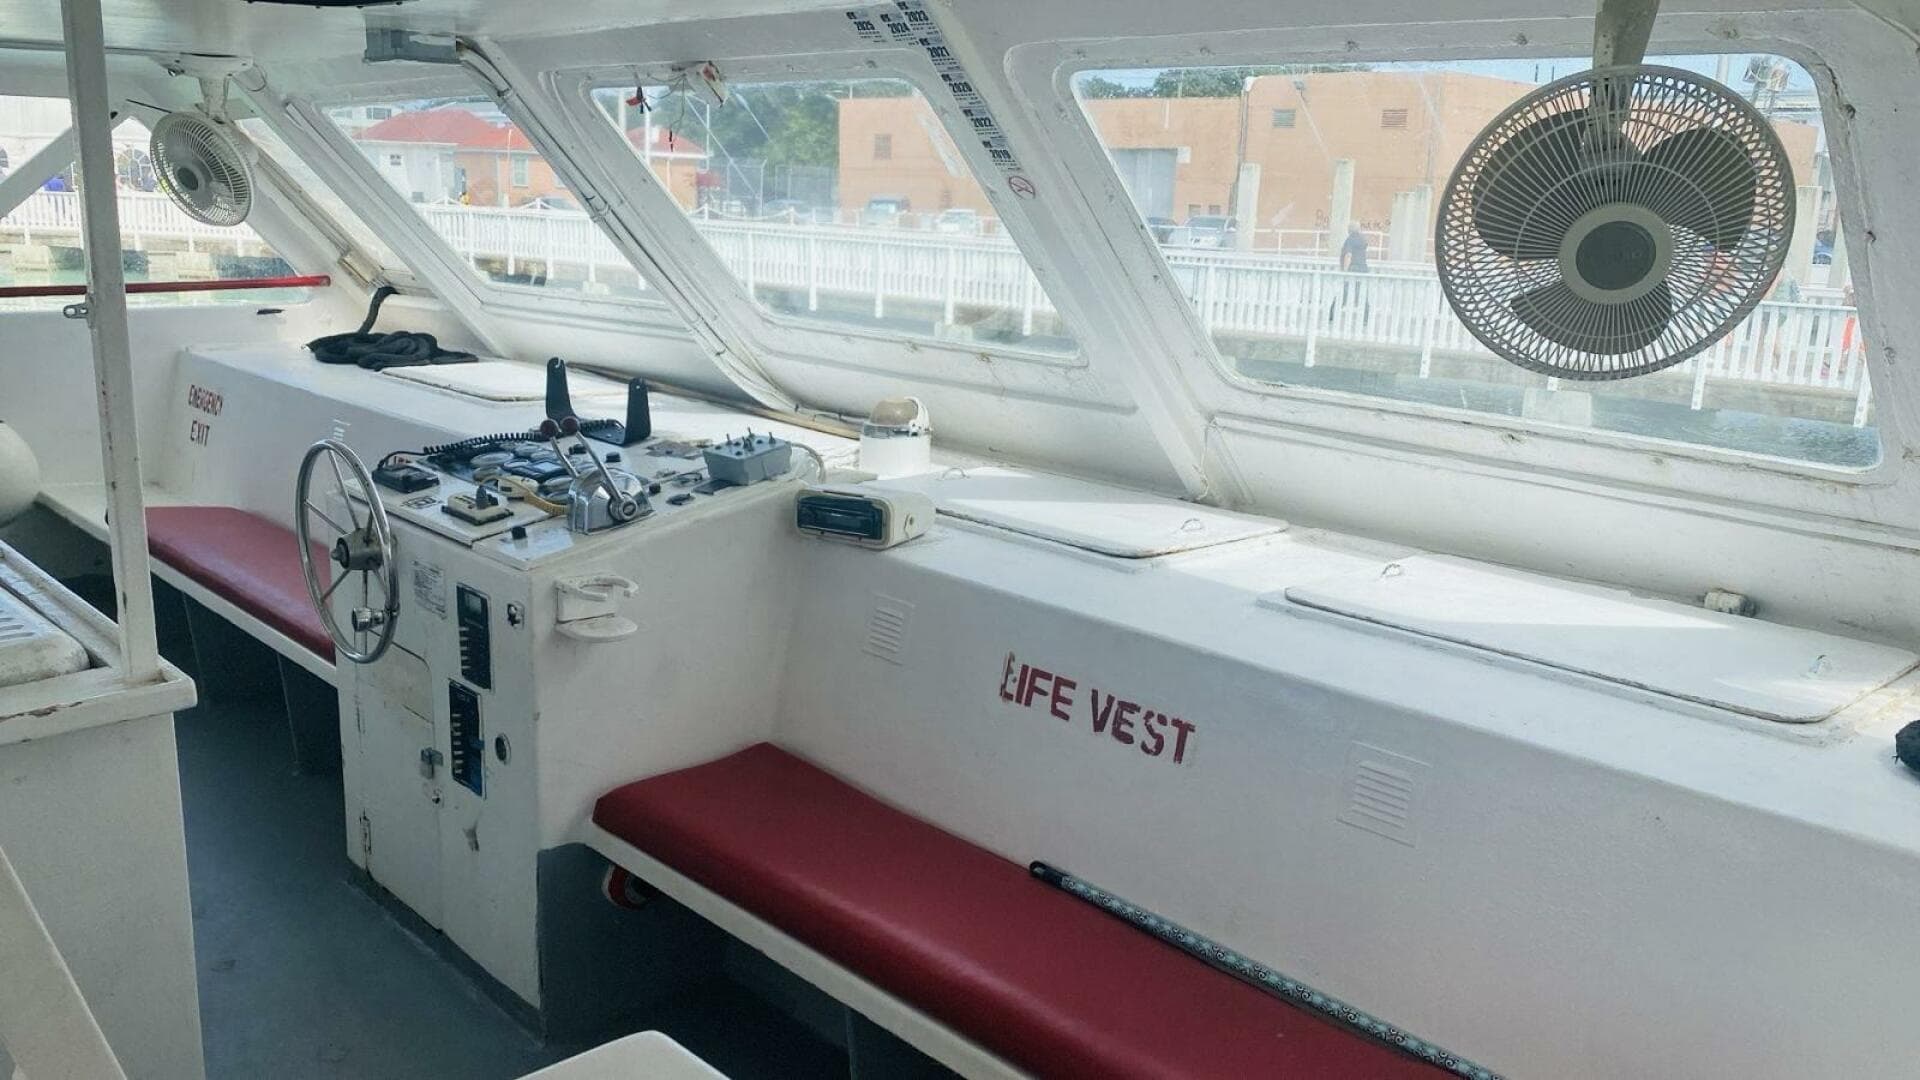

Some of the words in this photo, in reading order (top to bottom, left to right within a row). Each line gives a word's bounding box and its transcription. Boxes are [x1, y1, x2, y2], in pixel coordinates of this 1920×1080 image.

[906, 10, 929, 22] 2023
[855, 20, 875, 31] 2025
[888, 23, 910, 34] 2024
[927, 46, 950, 58] 2021
[950, 81, 973, 94] 2020
[972, 117, 994, 128] 2022
[190, 420, 210, 447] EXIT
[999, 650, 1077, 722] LIFE
[1090, 688, 1196, 765] VEST
